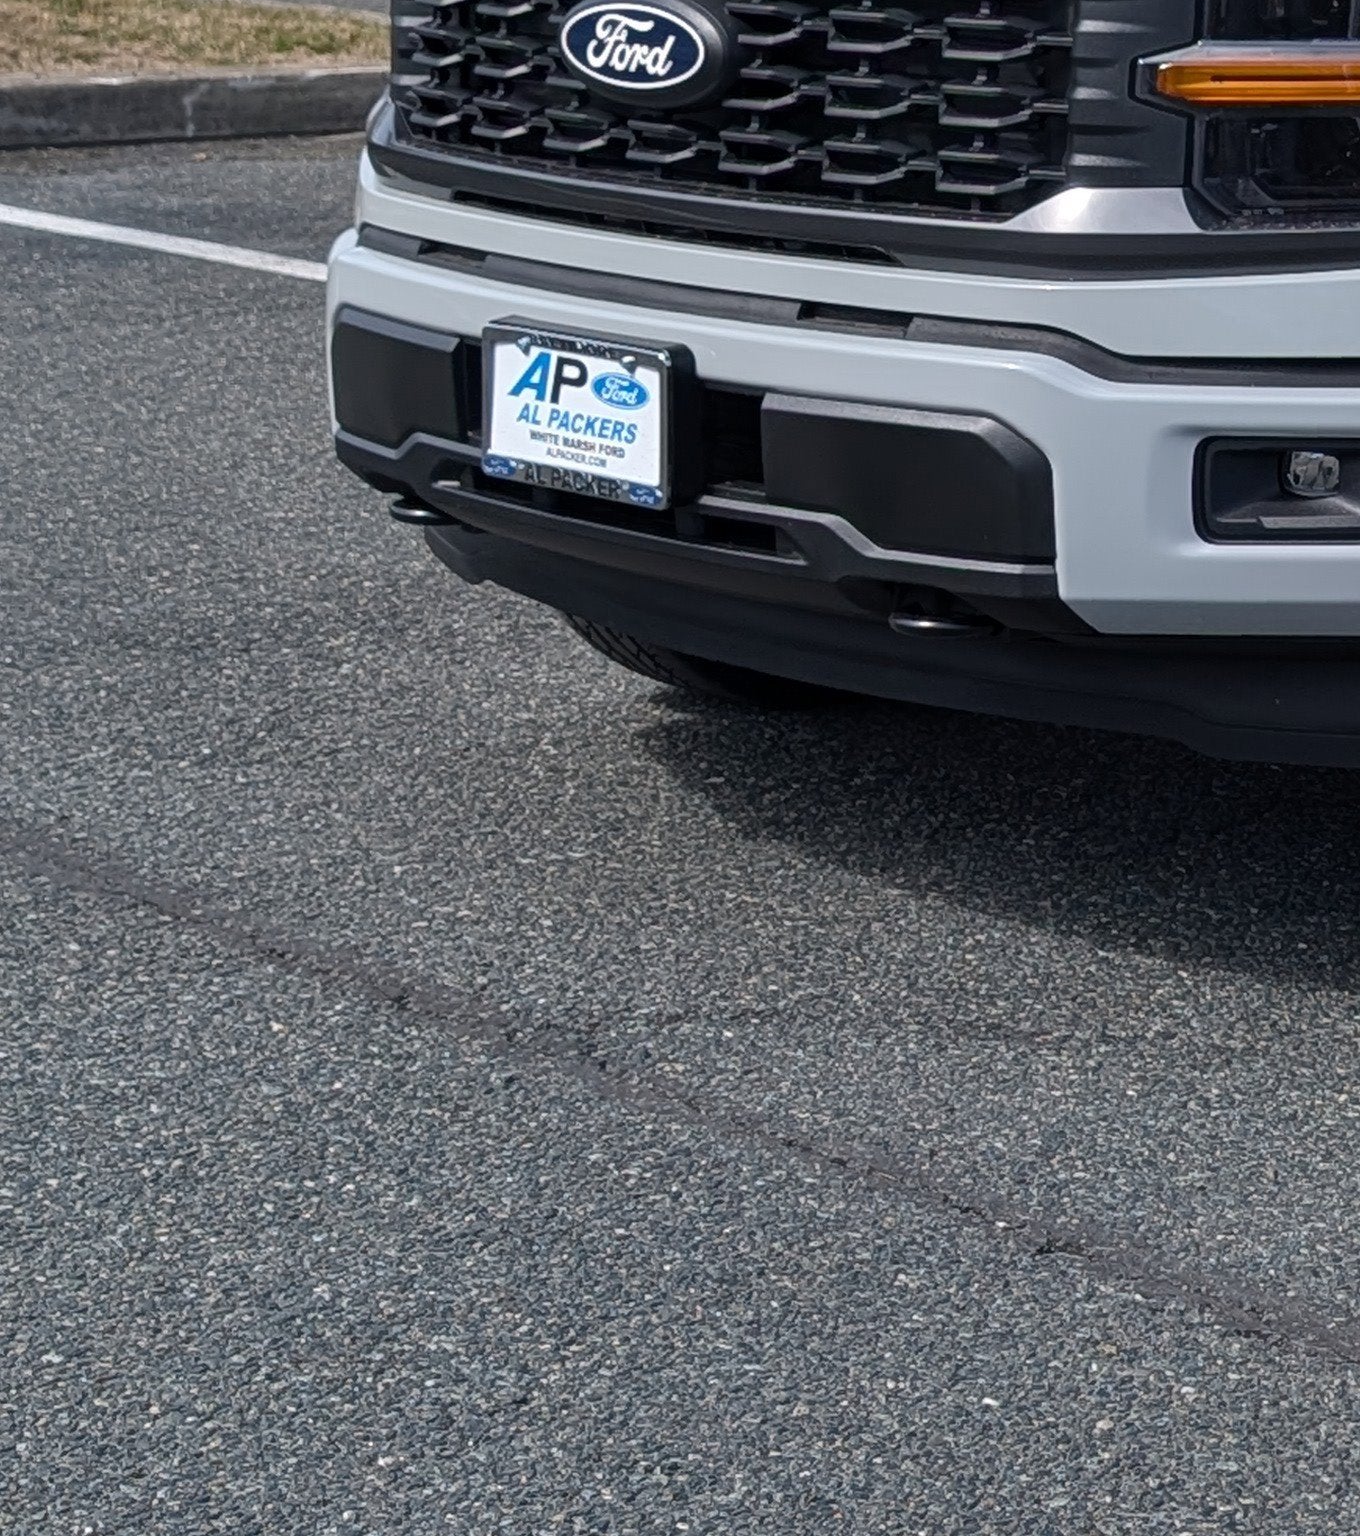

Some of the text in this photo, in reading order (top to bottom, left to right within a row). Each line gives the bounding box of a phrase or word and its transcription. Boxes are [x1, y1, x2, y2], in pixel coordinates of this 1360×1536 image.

[586, 13, 677, 77] Ford
[507, 351, 588, 405] AP
[600, 376, 640, 406] Ford
[516, 403, 639, 445] AL PACKERS
[551, 467, 622, 498] PACKER
